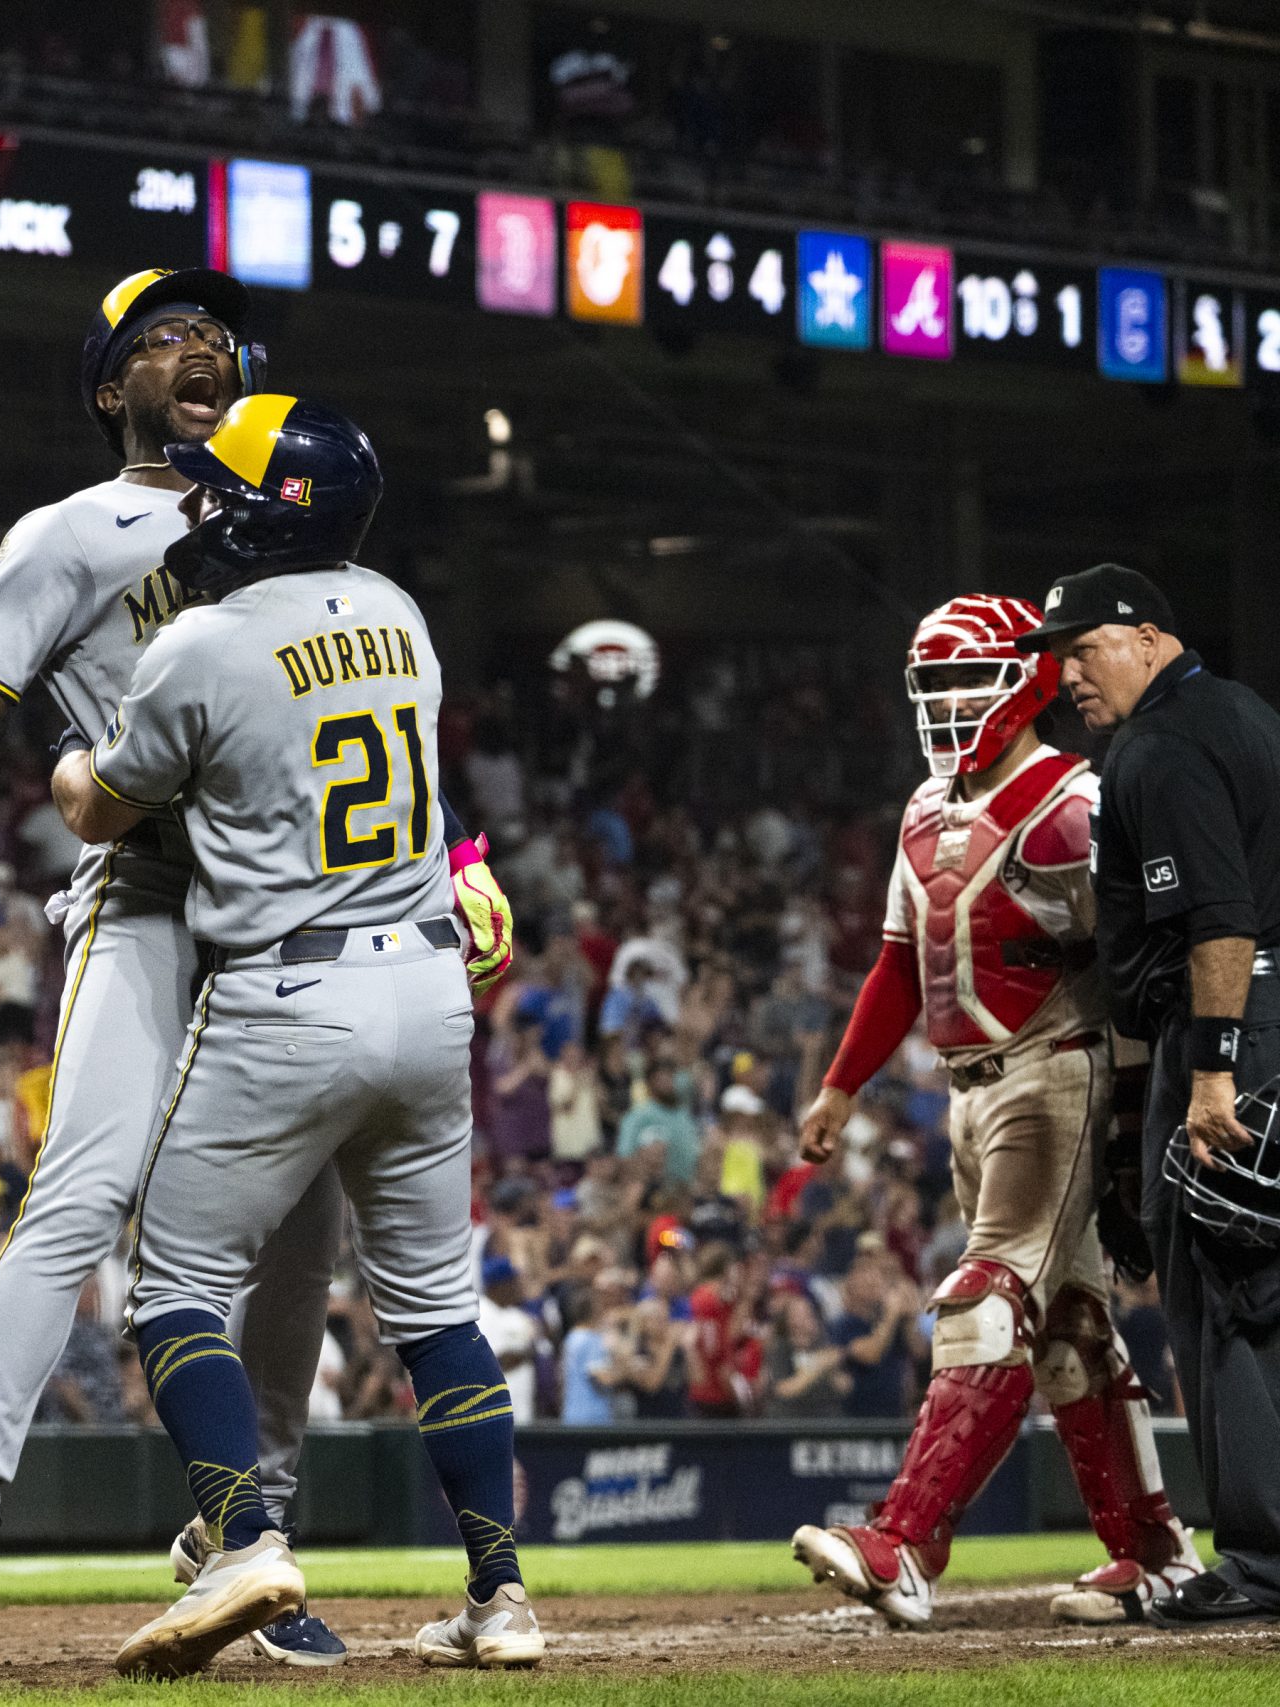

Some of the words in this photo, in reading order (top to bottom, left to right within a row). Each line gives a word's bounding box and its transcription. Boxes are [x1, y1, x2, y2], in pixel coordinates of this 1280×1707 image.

[328, 199, 367, 269] 5
[425, 209, 460, 277] 7
[657, 240, 696, 306] 4
[748, 249, 786, 316] 4
[957, 273, 1013, 341] 10
[1056, 284, 1082, 348] 1
[282, 478, 312, 506] 21
[272, 625, 420, 699] DURBIN
[311, 702, 432, 874] 21
[1150, 865, 1173, 885] JS
